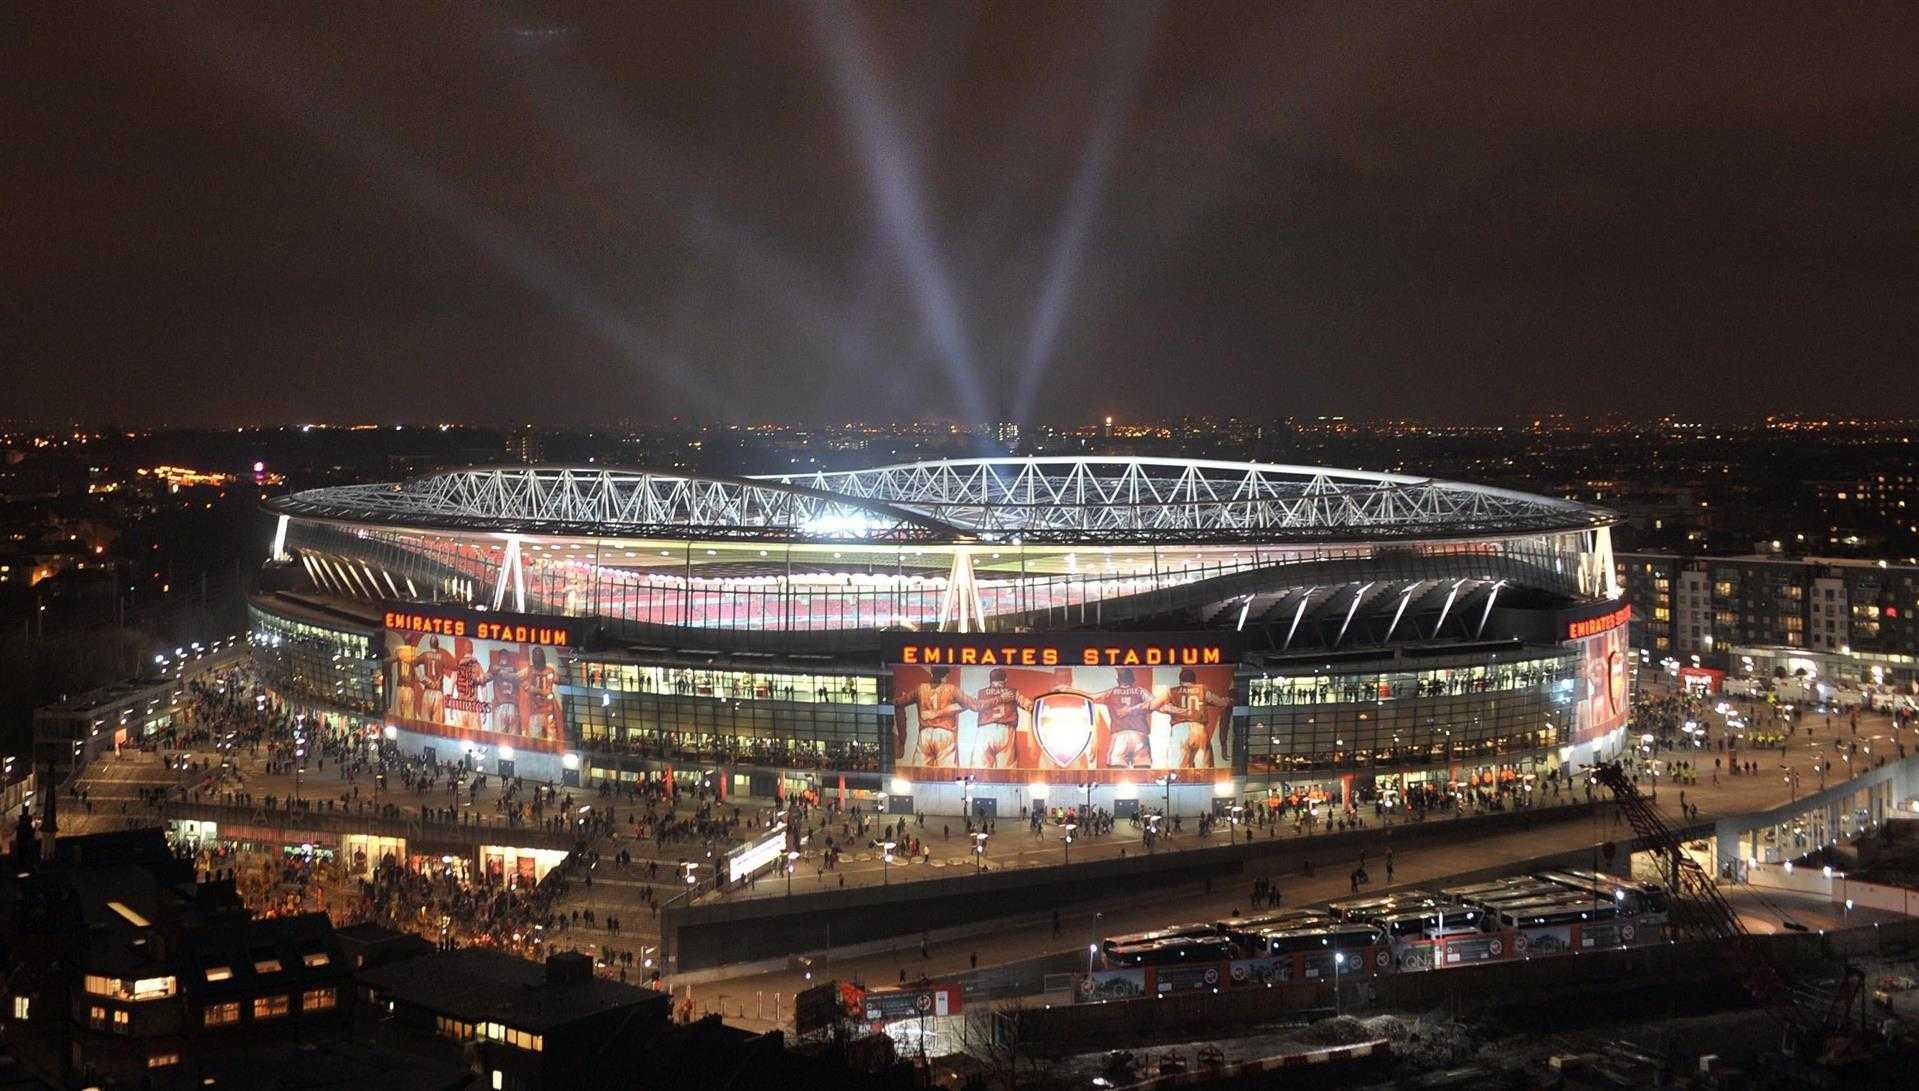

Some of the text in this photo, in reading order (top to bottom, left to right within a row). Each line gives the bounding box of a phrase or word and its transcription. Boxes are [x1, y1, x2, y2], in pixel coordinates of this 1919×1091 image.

[385, 613, 567, 645] EMIRATES STADIUM
[903, 646, 1222, 665] EMIRATES STADIUM
